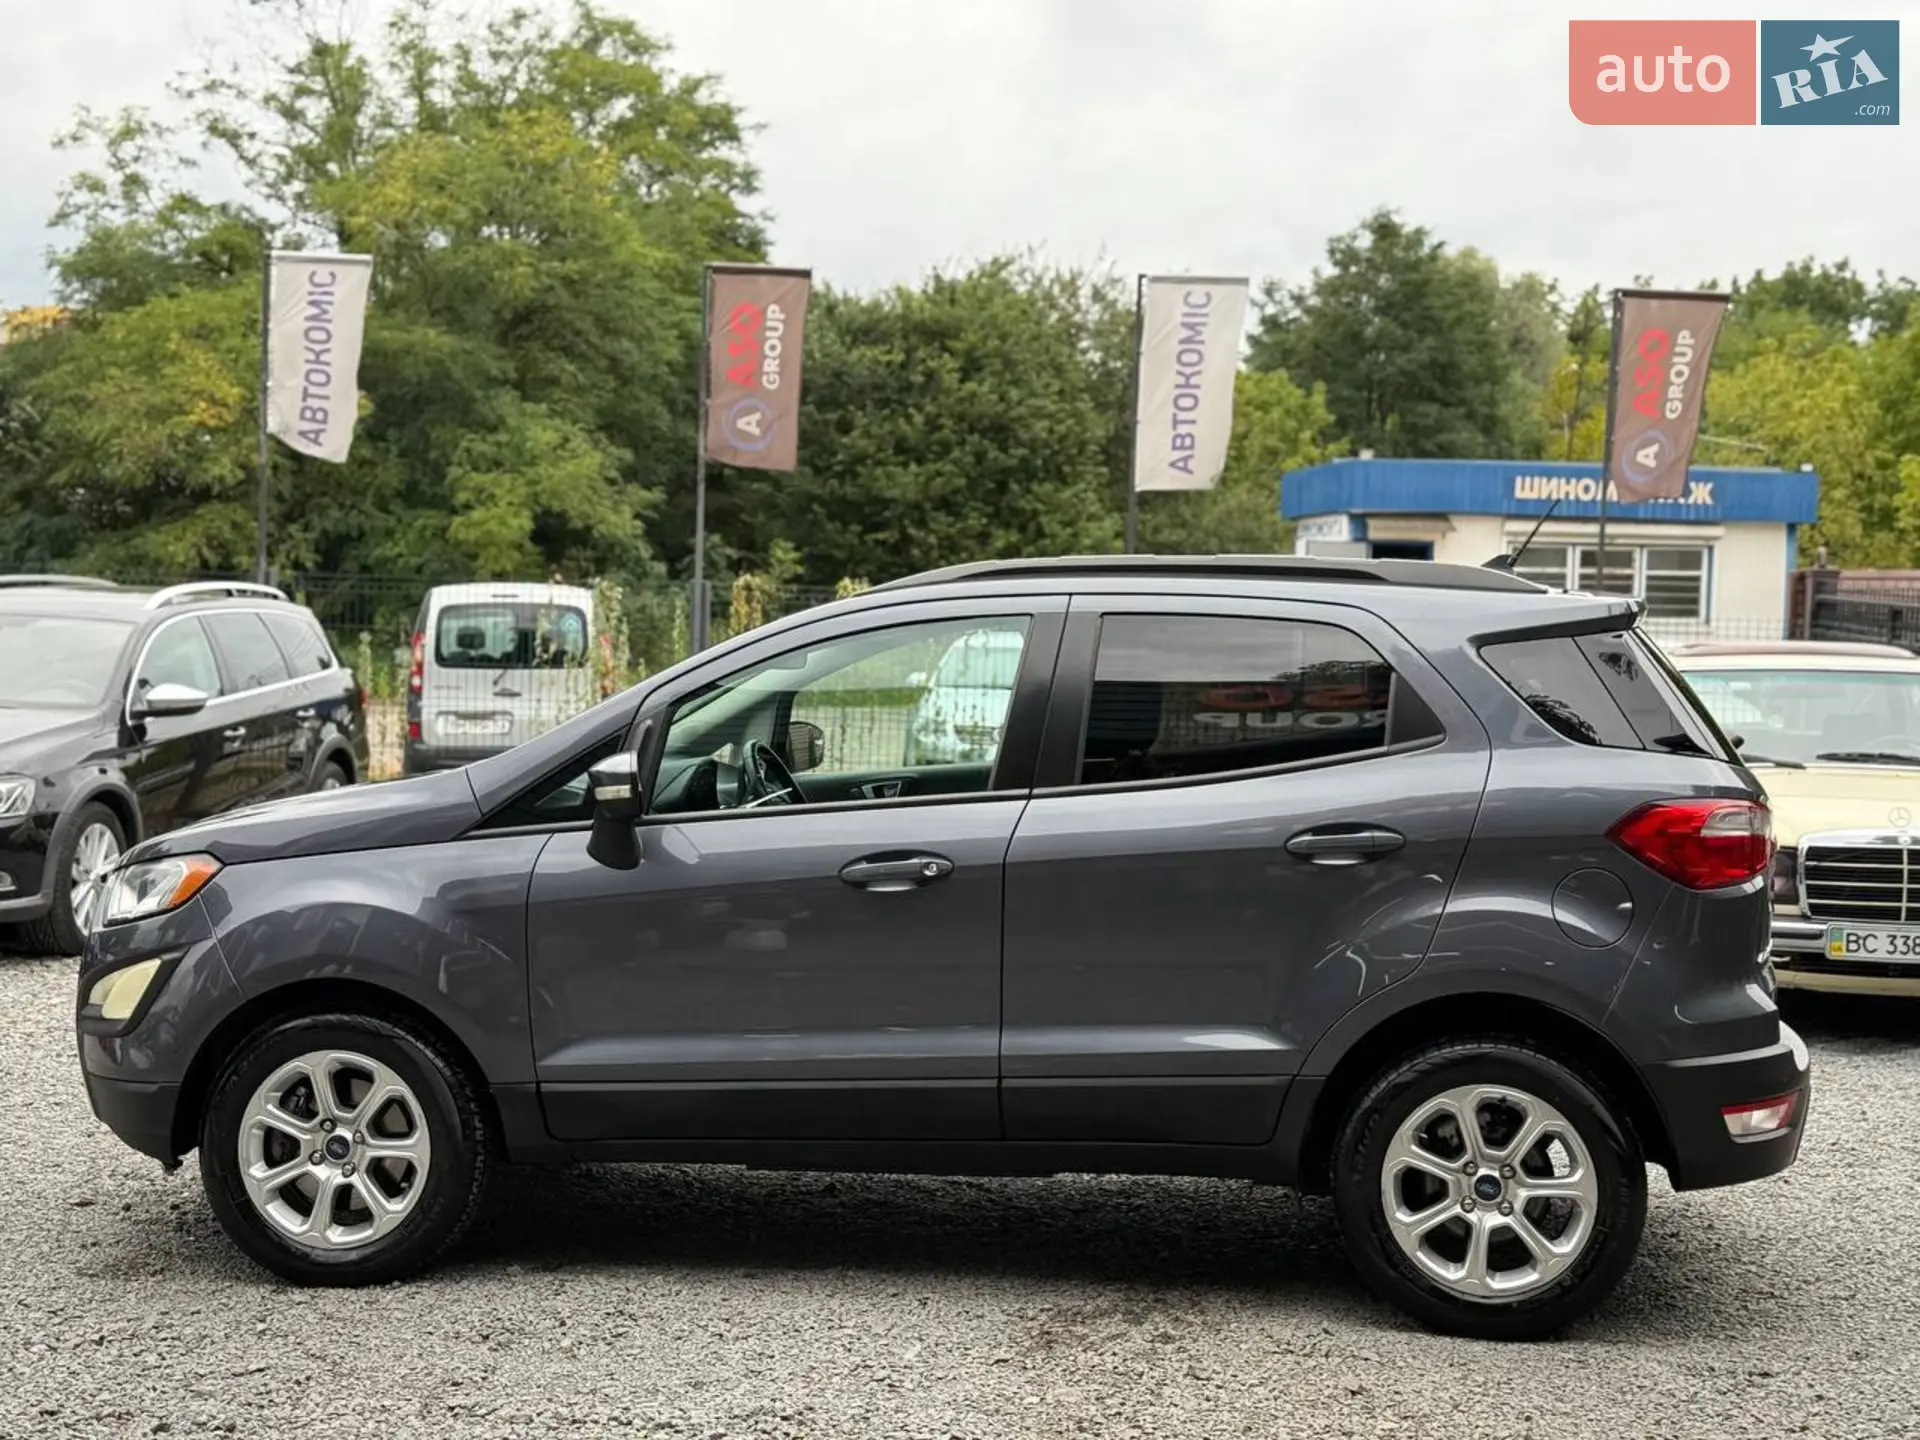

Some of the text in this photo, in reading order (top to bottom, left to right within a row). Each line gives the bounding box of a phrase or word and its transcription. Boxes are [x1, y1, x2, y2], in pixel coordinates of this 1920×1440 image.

[297, 270, 337, 447] АВТОКОМІС
[762, 303, 787, 390] GROUP
[1168, 290, 1212, 476] АВТОКОМІС
[1632, 327, 1671, 418] ASO
[1665, 329, 1696, 420] GROUP
[1514, 475, 1713, 505] ШИНОМЖ
[1846, 932, 1878, 954] BC
[1886, 934, 1920, 956] 338
